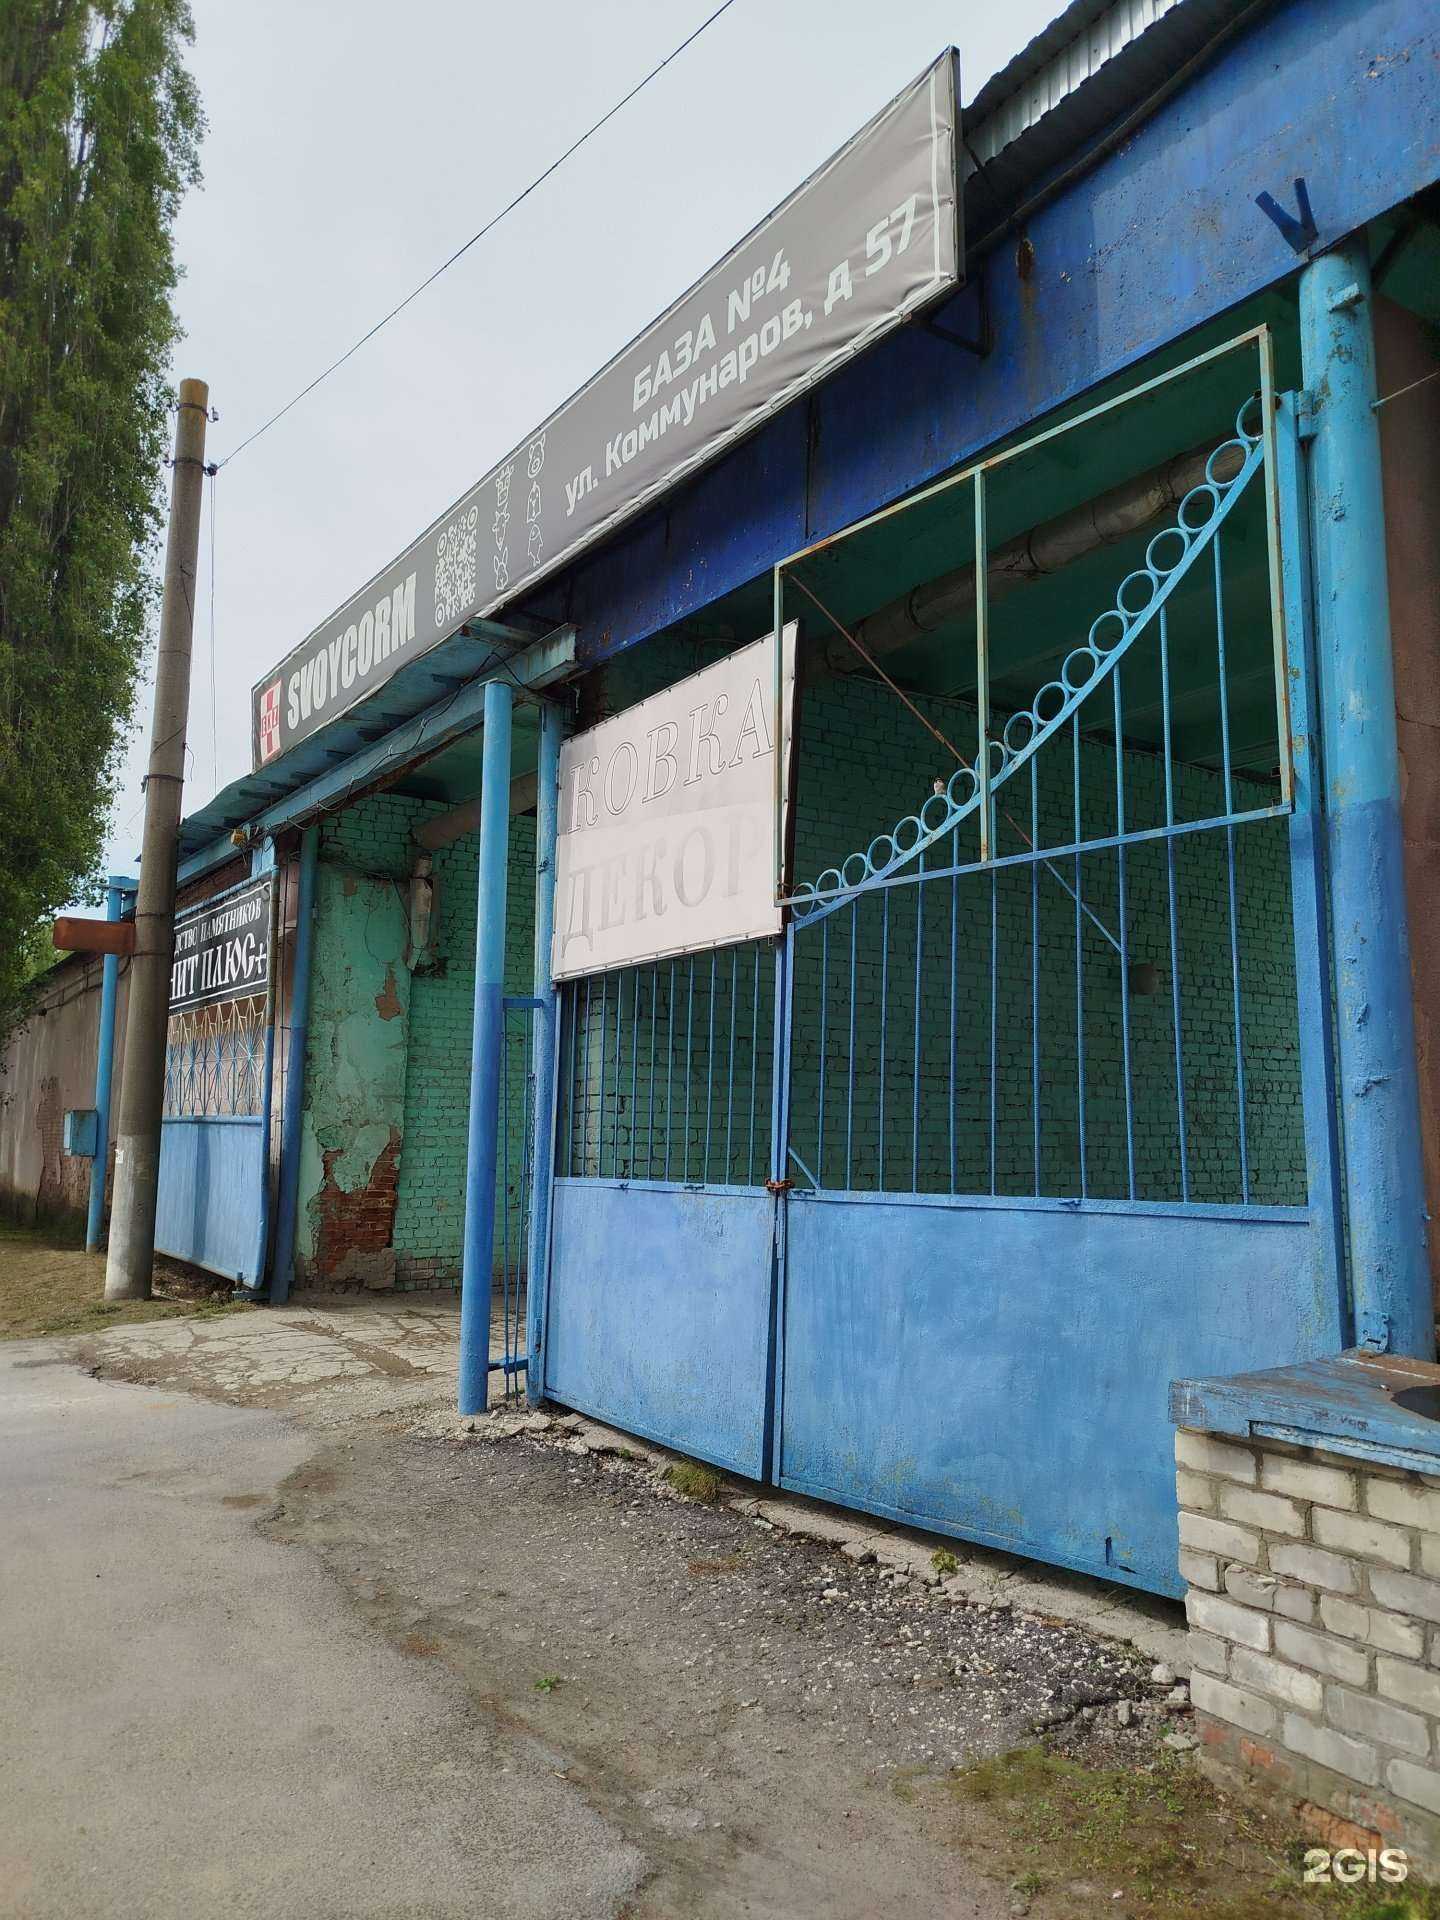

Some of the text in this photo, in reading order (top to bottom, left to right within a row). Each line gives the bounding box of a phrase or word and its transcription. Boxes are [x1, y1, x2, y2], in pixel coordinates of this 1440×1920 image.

[565, 464, 599, 517] ул.
[604, 297, 814, 478] Коммунаров,
[864, 194, 917, 279] 57
[633, 247, 792, 413] БАЗА №4
[286, 571, 417, 731] SVOYCORM
[567, 678, 776, 835] КОВКА
[200, 898, 262, 942] ПАМЯТНИКОВ
[560, 812, 768, 959] ДЕКОР
